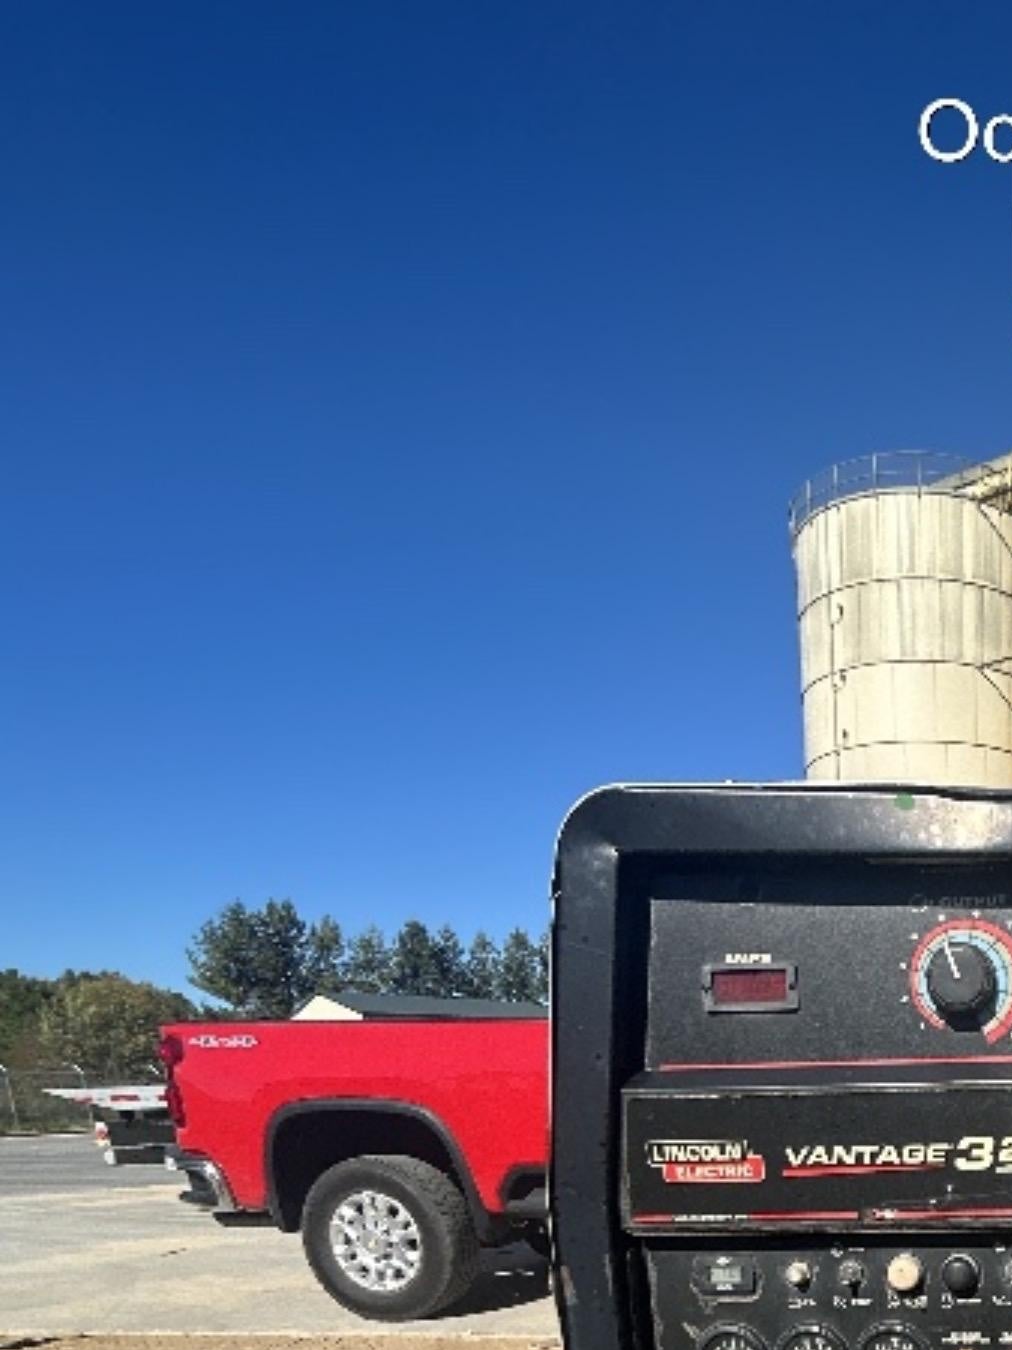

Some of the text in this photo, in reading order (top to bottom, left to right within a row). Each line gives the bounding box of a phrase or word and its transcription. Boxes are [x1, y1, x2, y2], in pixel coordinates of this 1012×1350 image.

[652, 1144, 743, 1162] LINCOLN
[786, 1143, 948, 1166] VANTAGE
[674, 1162, 753, 1178] ELECTRIC
